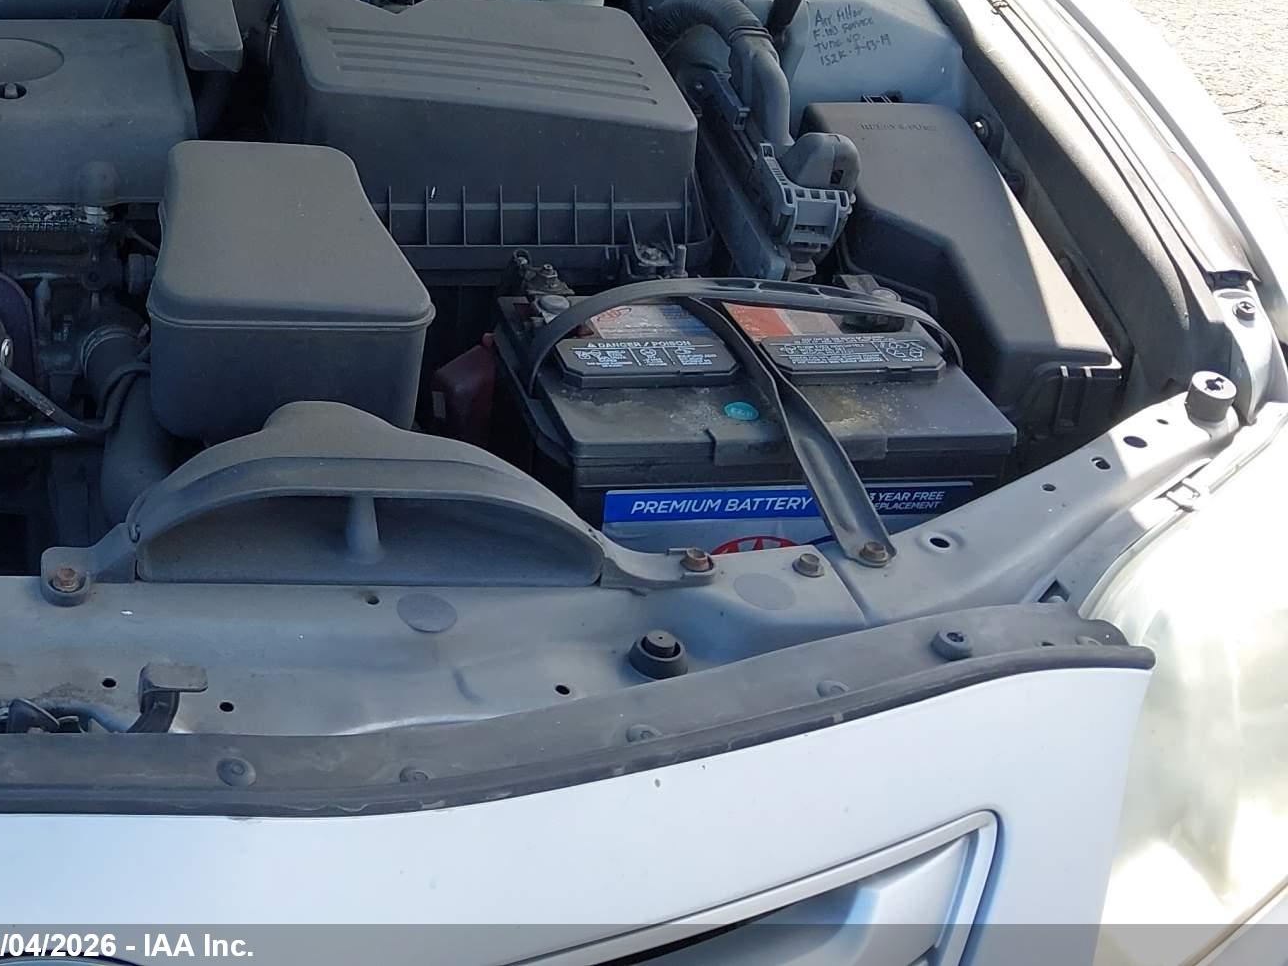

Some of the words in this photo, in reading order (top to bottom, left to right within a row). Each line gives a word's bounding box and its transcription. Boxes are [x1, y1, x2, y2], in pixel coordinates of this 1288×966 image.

[878, 492, 911, 502] YEAR
[912, 491, 945, 501] FREE
[630, 498, 722, 515] PREMIUM
[724, 495, 814, 513] BATTERY
[874, 501, 940, 511] EPLACEMENT
